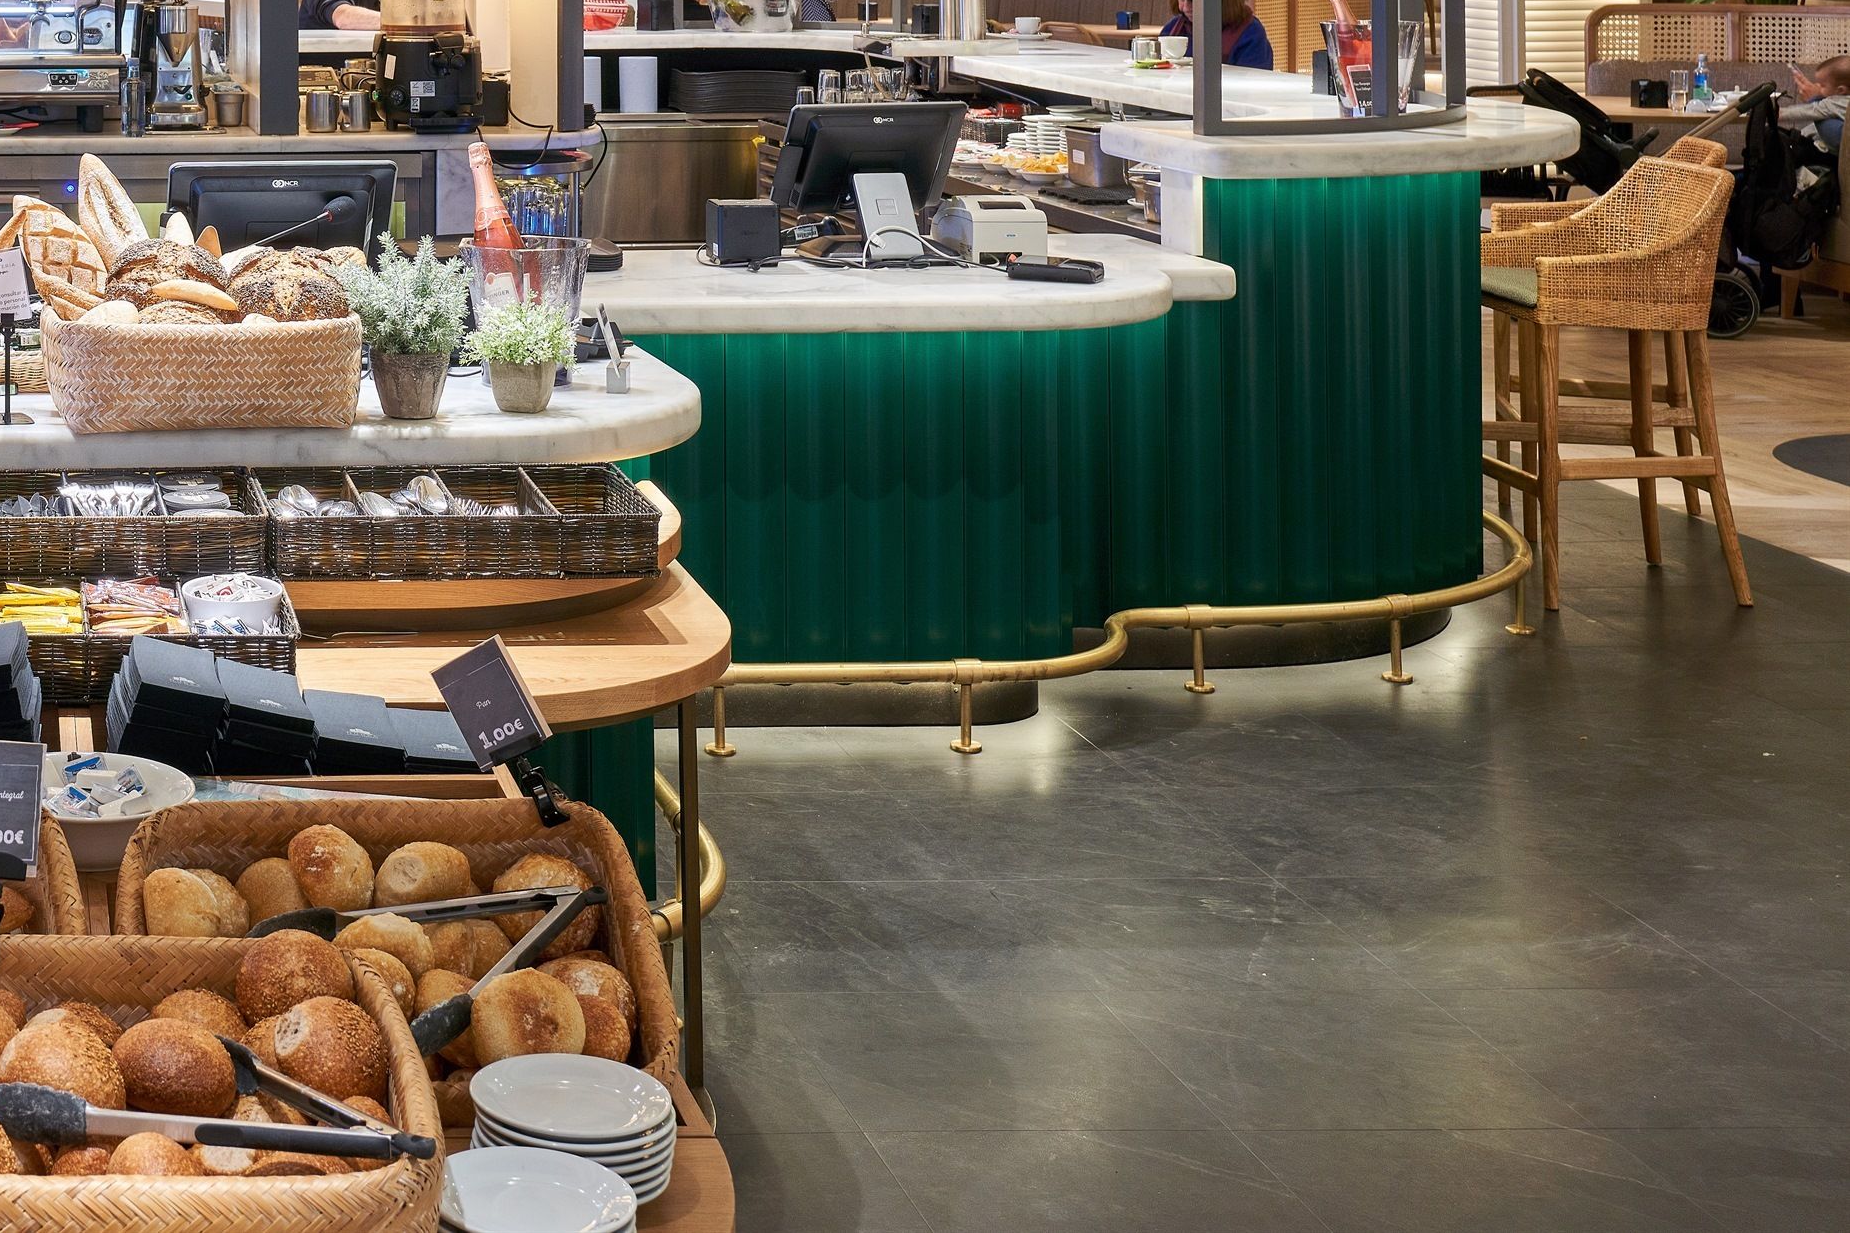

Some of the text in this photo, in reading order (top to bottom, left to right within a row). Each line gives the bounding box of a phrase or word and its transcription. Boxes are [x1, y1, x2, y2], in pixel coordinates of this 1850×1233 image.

[4, 297, 25, 305] personal
[476, 698, 492, 710] Pan
[478, 718, 524, 750] 1,00€
